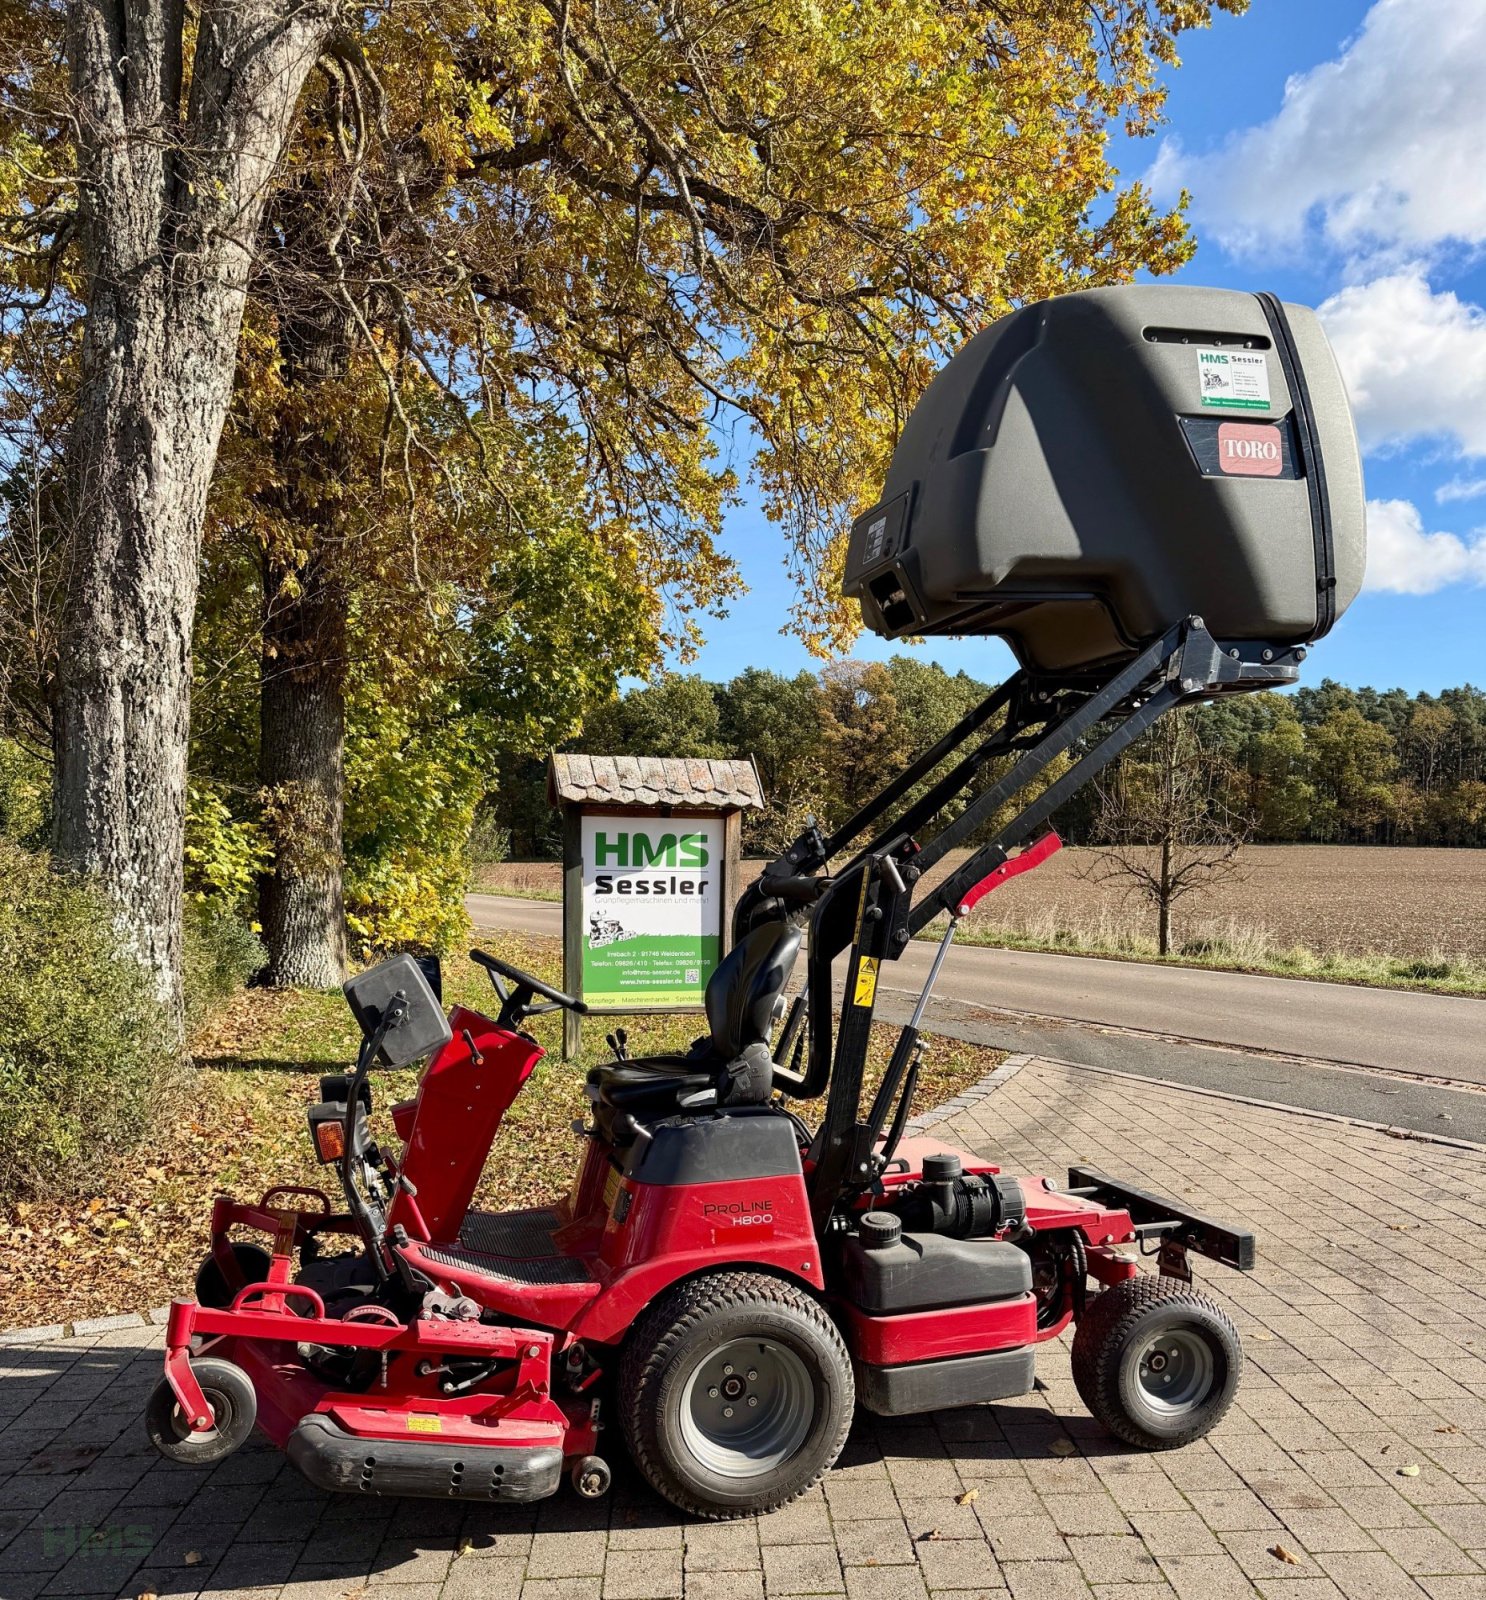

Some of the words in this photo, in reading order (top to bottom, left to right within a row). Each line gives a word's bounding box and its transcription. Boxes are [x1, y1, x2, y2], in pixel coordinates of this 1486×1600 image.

[1200, 353, 1229, 365] HMS
[1231, 355, 1263, 364] Sessler
[1224, 439, 1277, 460] TORO
[595, 832, 709, 867] HMS
[595, 875, 708, 895] Sessler
[594, 896, 673, 906] Grünpflegemaschinen
[674, 896, 688, 904] und
[703, 1200, 772, 1216] PROLINE
[733, 1214, 773, 1226] H800
